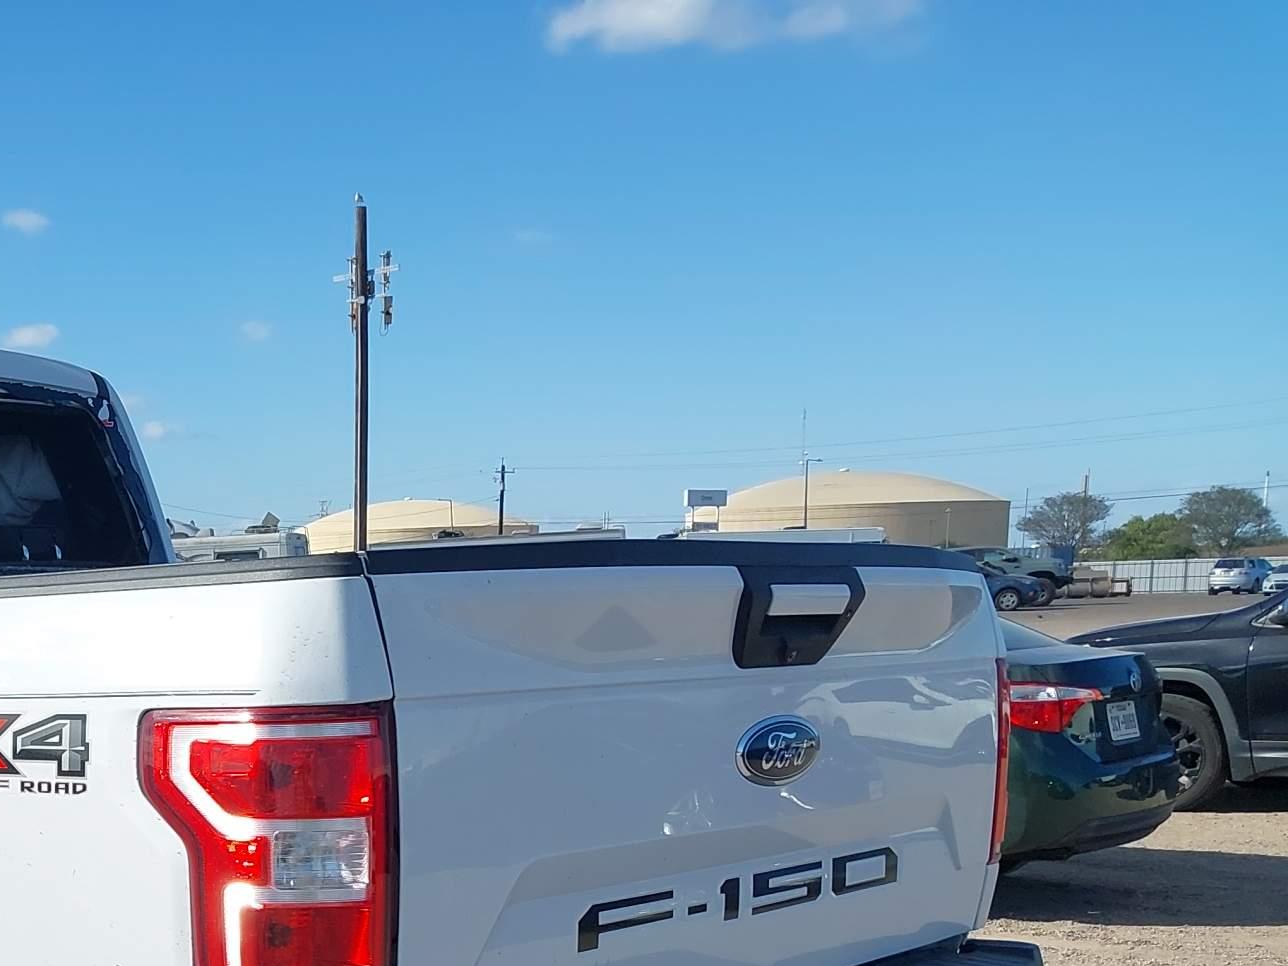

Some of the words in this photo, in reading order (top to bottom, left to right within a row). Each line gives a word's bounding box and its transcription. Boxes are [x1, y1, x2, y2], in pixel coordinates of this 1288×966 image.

[762, 732, 816, 770] Ford
[20, 780, 87, 795] ROAD
[578, 846, 898, 952] F-150
